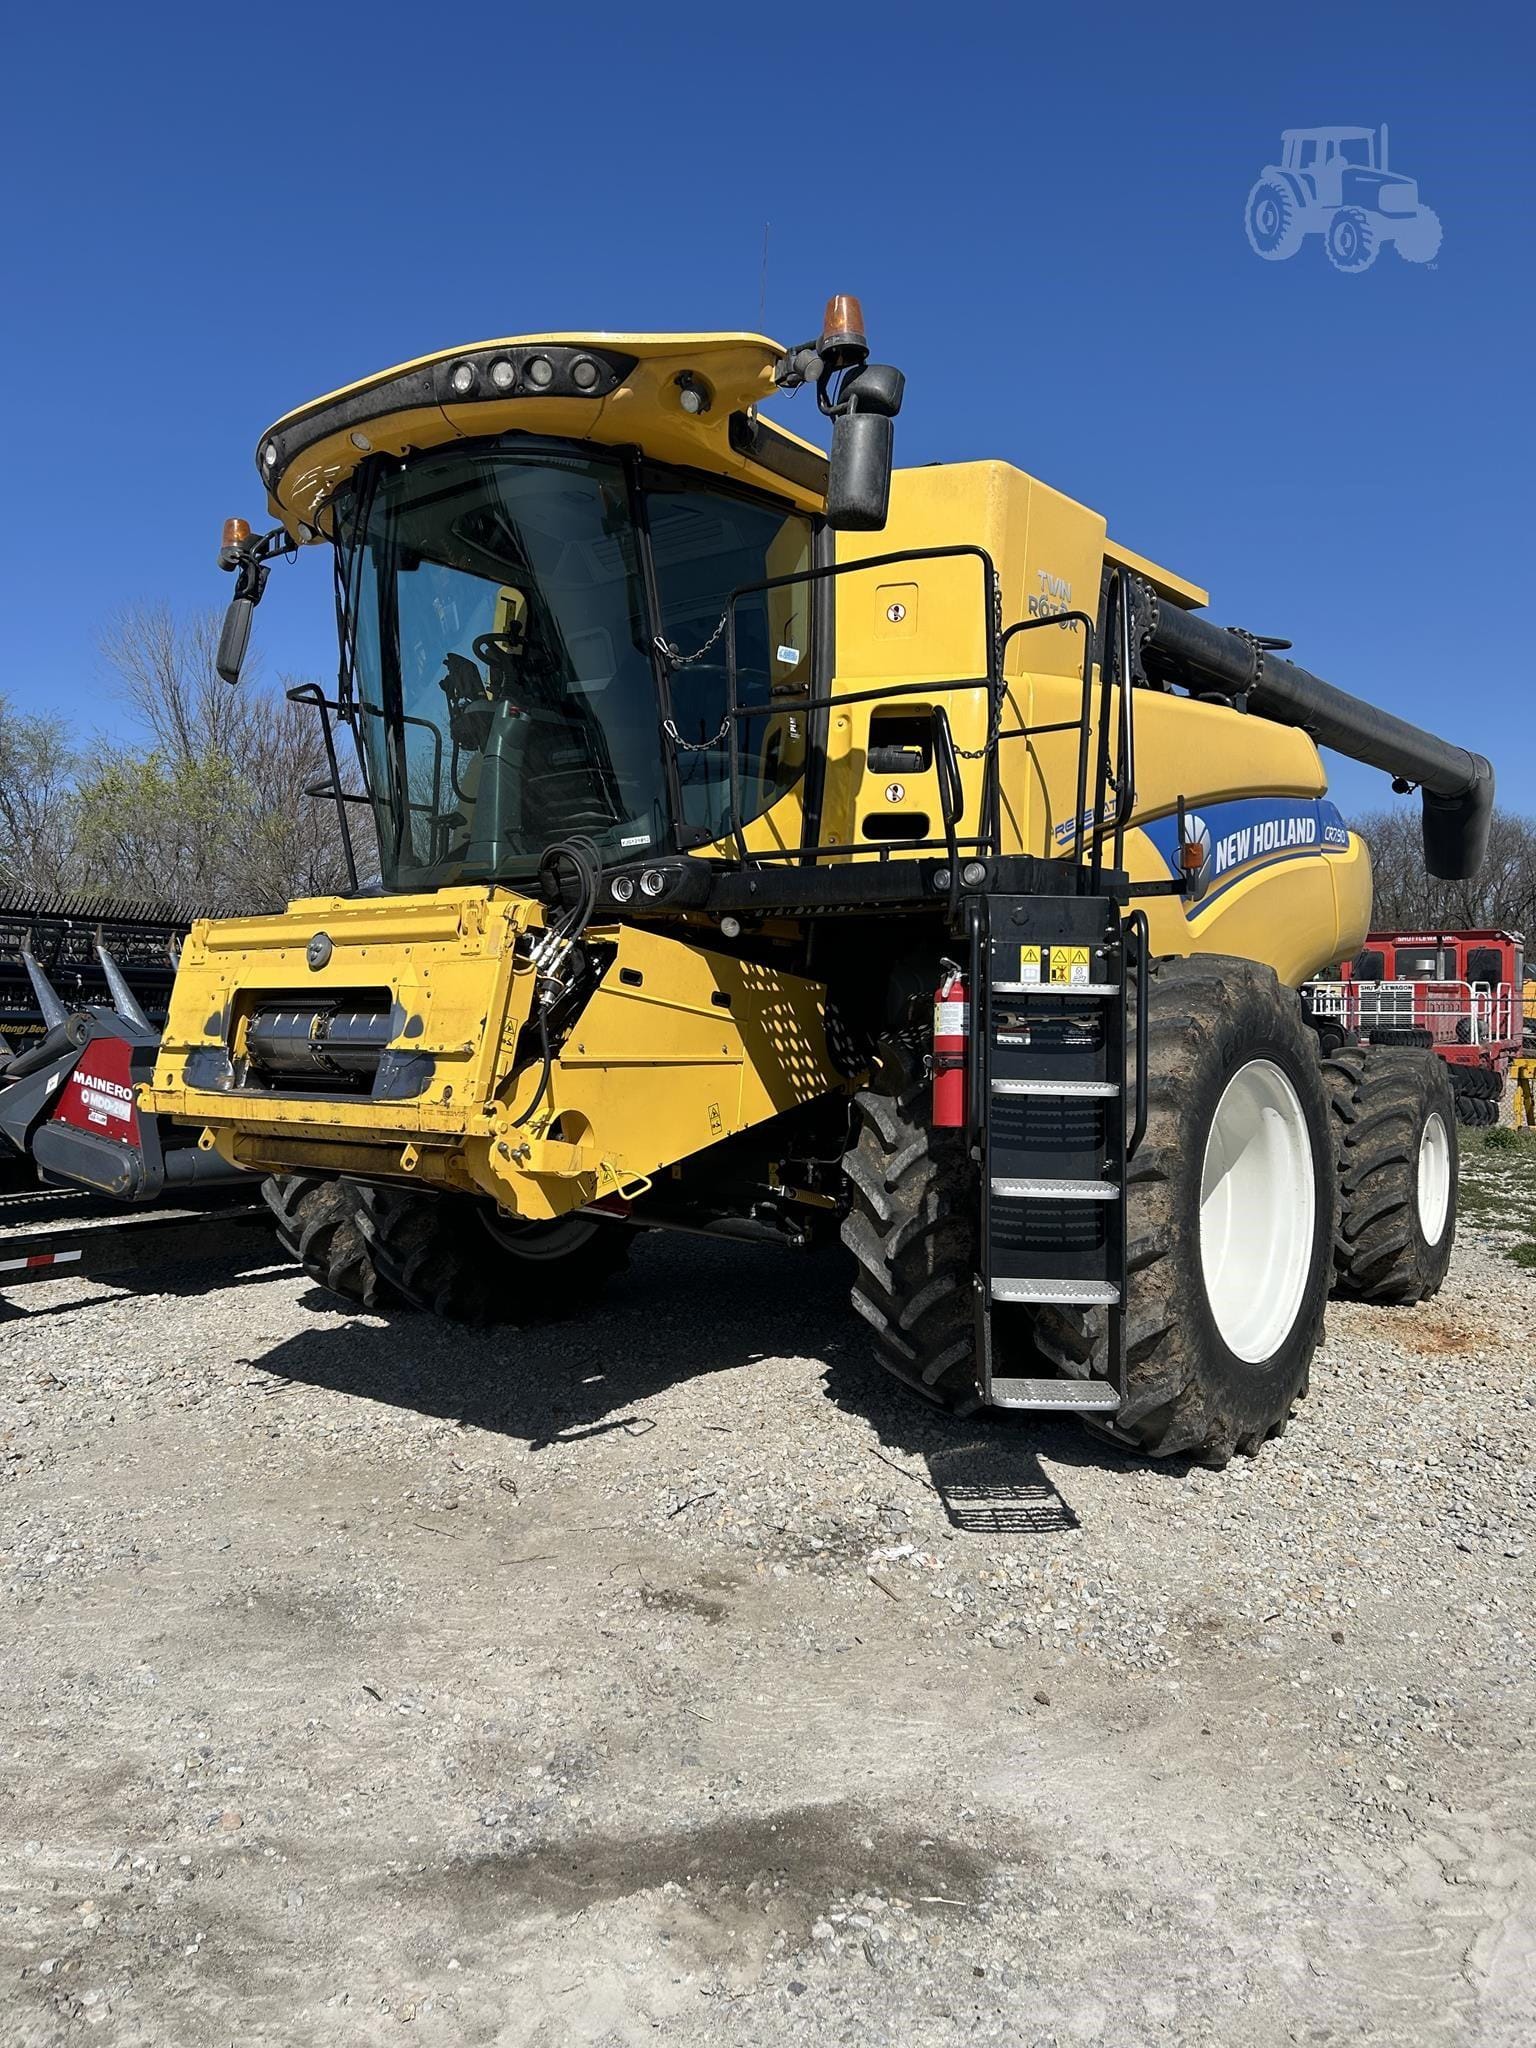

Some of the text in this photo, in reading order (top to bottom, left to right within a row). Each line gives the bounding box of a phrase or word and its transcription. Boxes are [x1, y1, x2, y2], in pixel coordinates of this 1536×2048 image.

[1037, 569, 1072, 603] TWIN
[1215, 817, 1316, 875] NEW HOLLAND
[0, 1024, 47, 1035] Honey Bee
[73, 1070, 133, 1101] MAINERO
